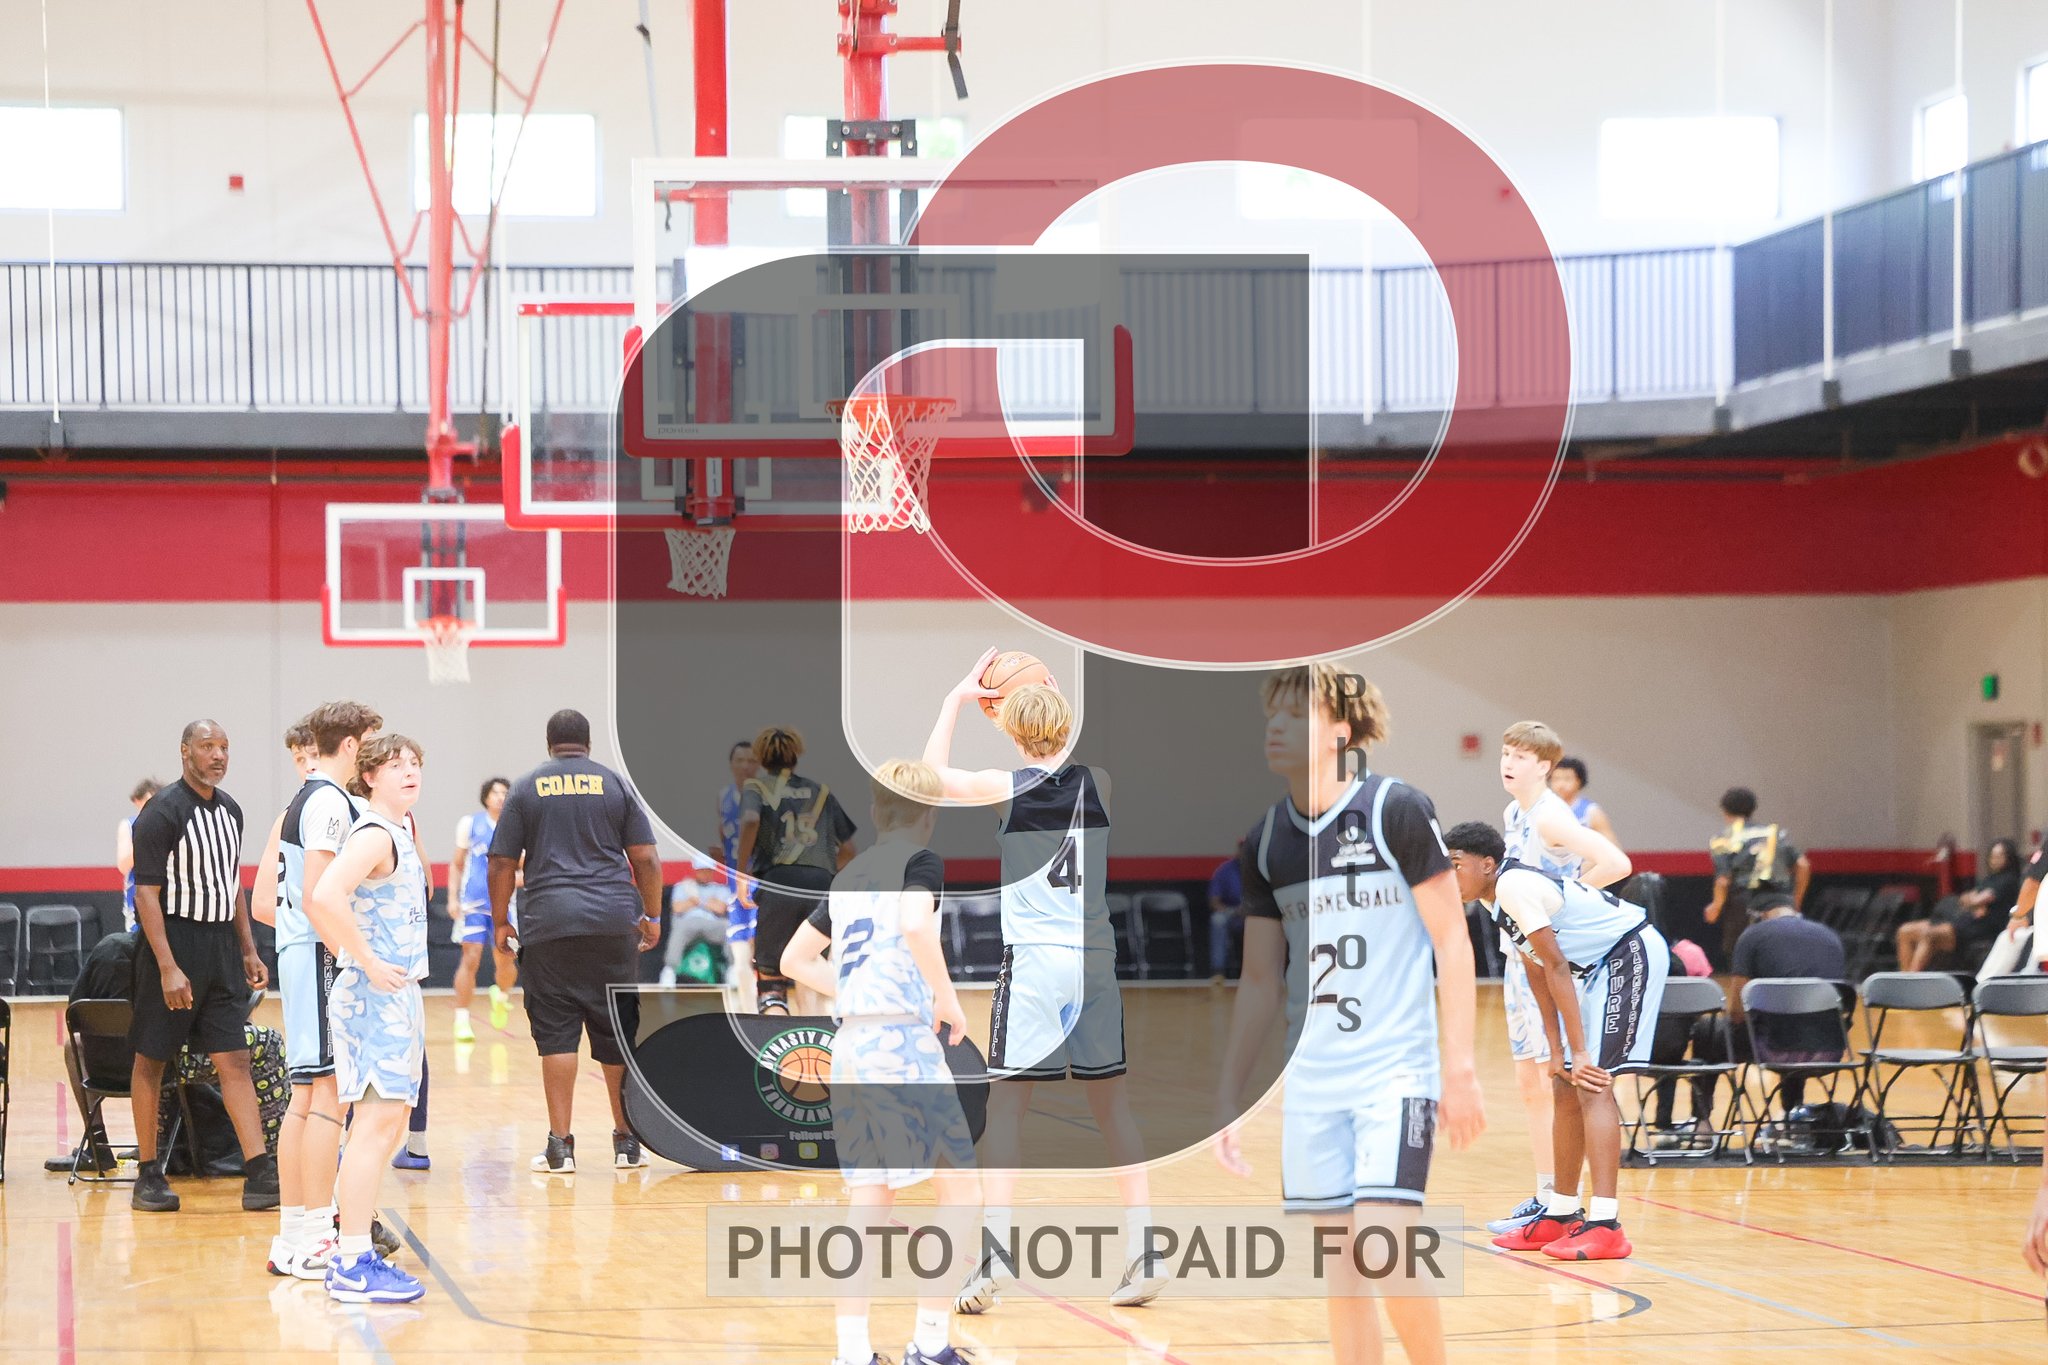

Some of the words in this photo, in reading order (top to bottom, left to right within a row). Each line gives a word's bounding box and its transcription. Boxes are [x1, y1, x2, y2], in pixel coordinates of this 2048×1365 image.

[535, 773, 604, 797] COACH
[1047, 836, 1083, 895] 4
[1297, 885, 1403, 918] BSKETBALL
[1604, 958, 1625, 1035] PURE
[760, 1030, 817, 1072] DYNASTY
[760, 1083, 832, 1123] TOURNAM
